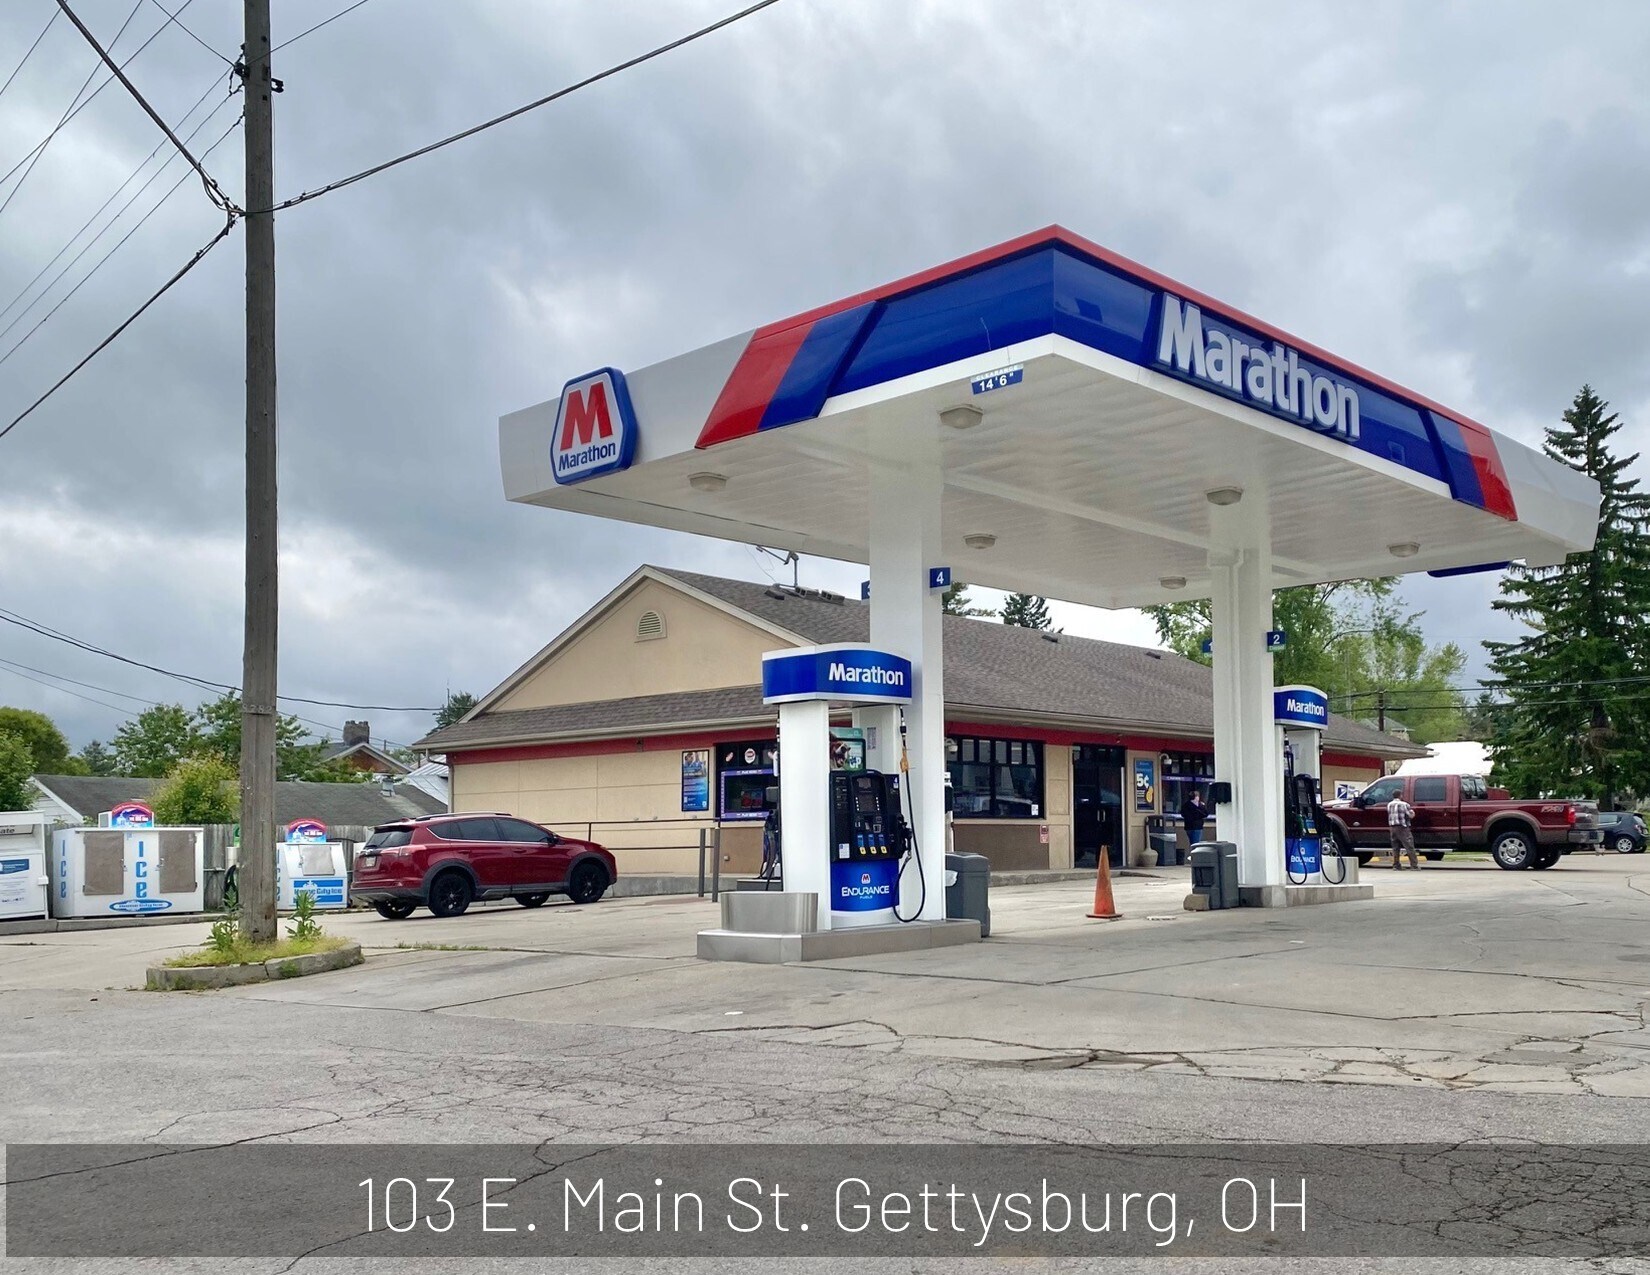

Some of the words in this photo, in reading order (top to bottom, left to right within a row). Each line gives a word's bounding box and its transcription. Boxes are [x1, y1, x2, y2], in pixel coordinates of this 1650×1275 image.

[976, 365, 1017, 380] CLEARANCE
[1158, 292, 1360, 439] Marathon
[560, 381, 613, 451] M
[558, 442, 616, 471] Marathon
[936, 571, 944, 585] 4
[1273, 634, 1280, 645] 2
[828, 662, 904, 686] Marathon
[1287, 698, 1325, 717] Marathon
[1136, 773, 1150, 789] 5¢
[135, 840, 148, 898] Ice
[841, 885, 890, 897] ENDURANCE
